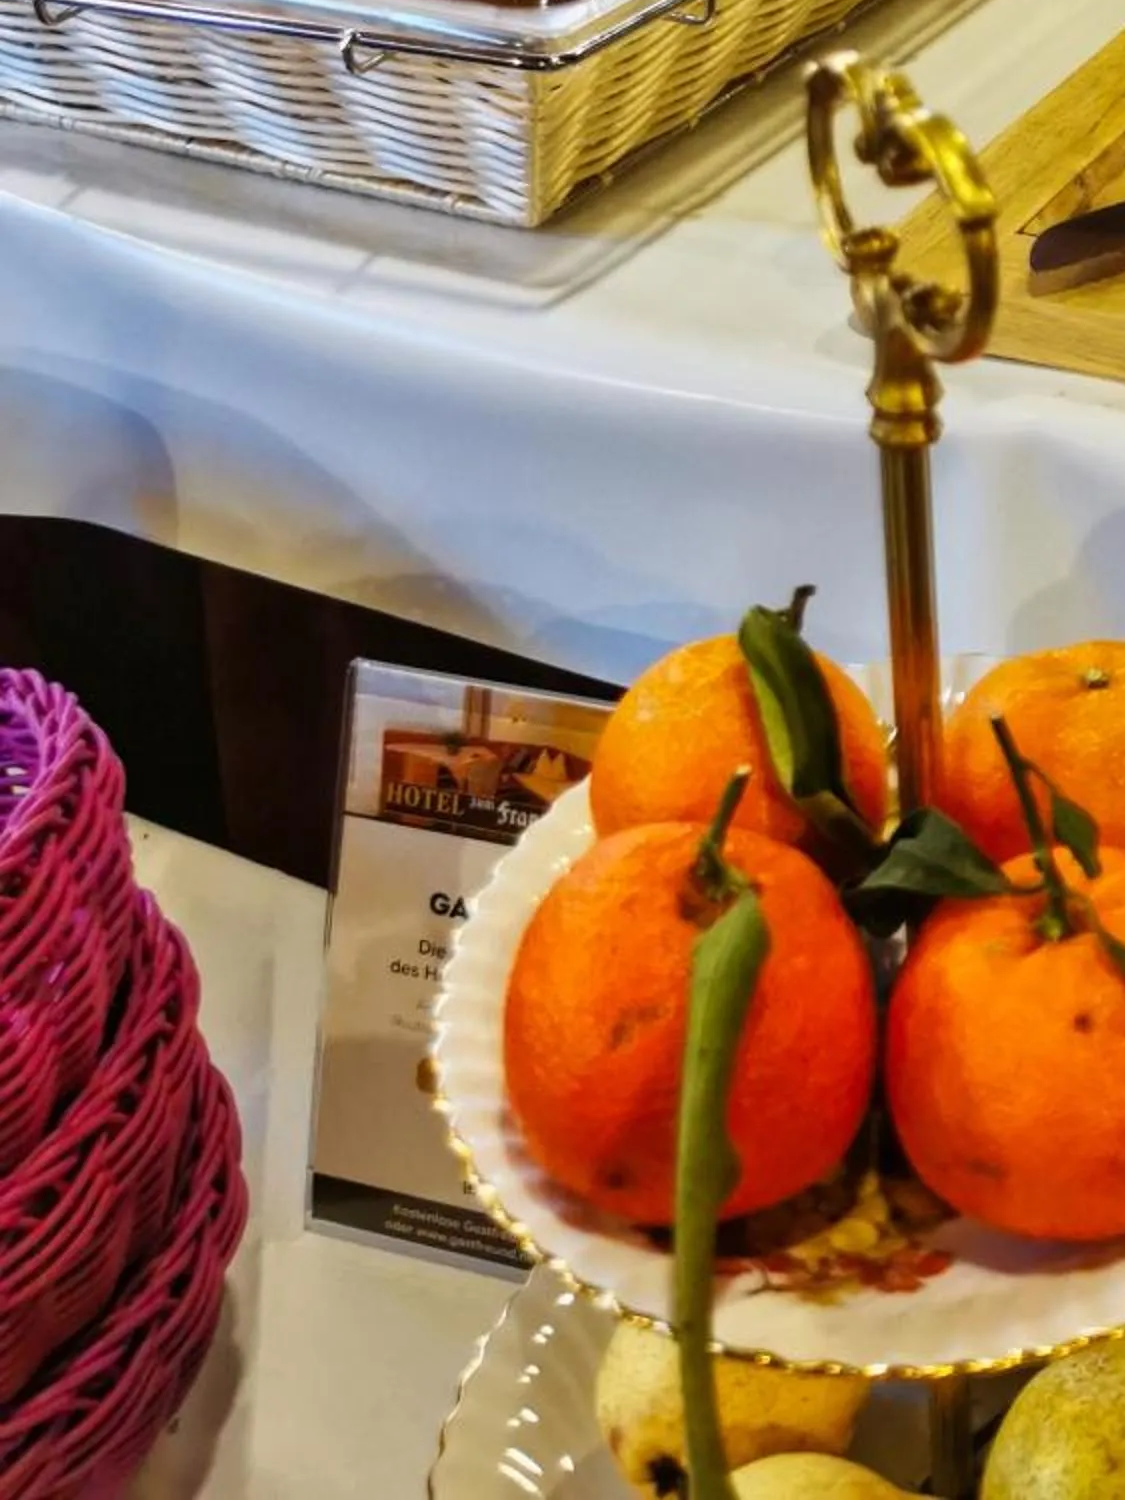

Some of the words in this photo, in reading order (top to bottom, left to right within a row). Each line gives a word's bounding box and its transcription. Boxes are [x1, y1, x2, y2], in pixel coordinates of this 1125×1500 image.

[386, 782, 465, 816] HOTEL
[429, 892, 469, 920] GA
[418, 939, 448, 960] Die
[389, 958, 420, 978] des
[424, 965, 442, 982] H
